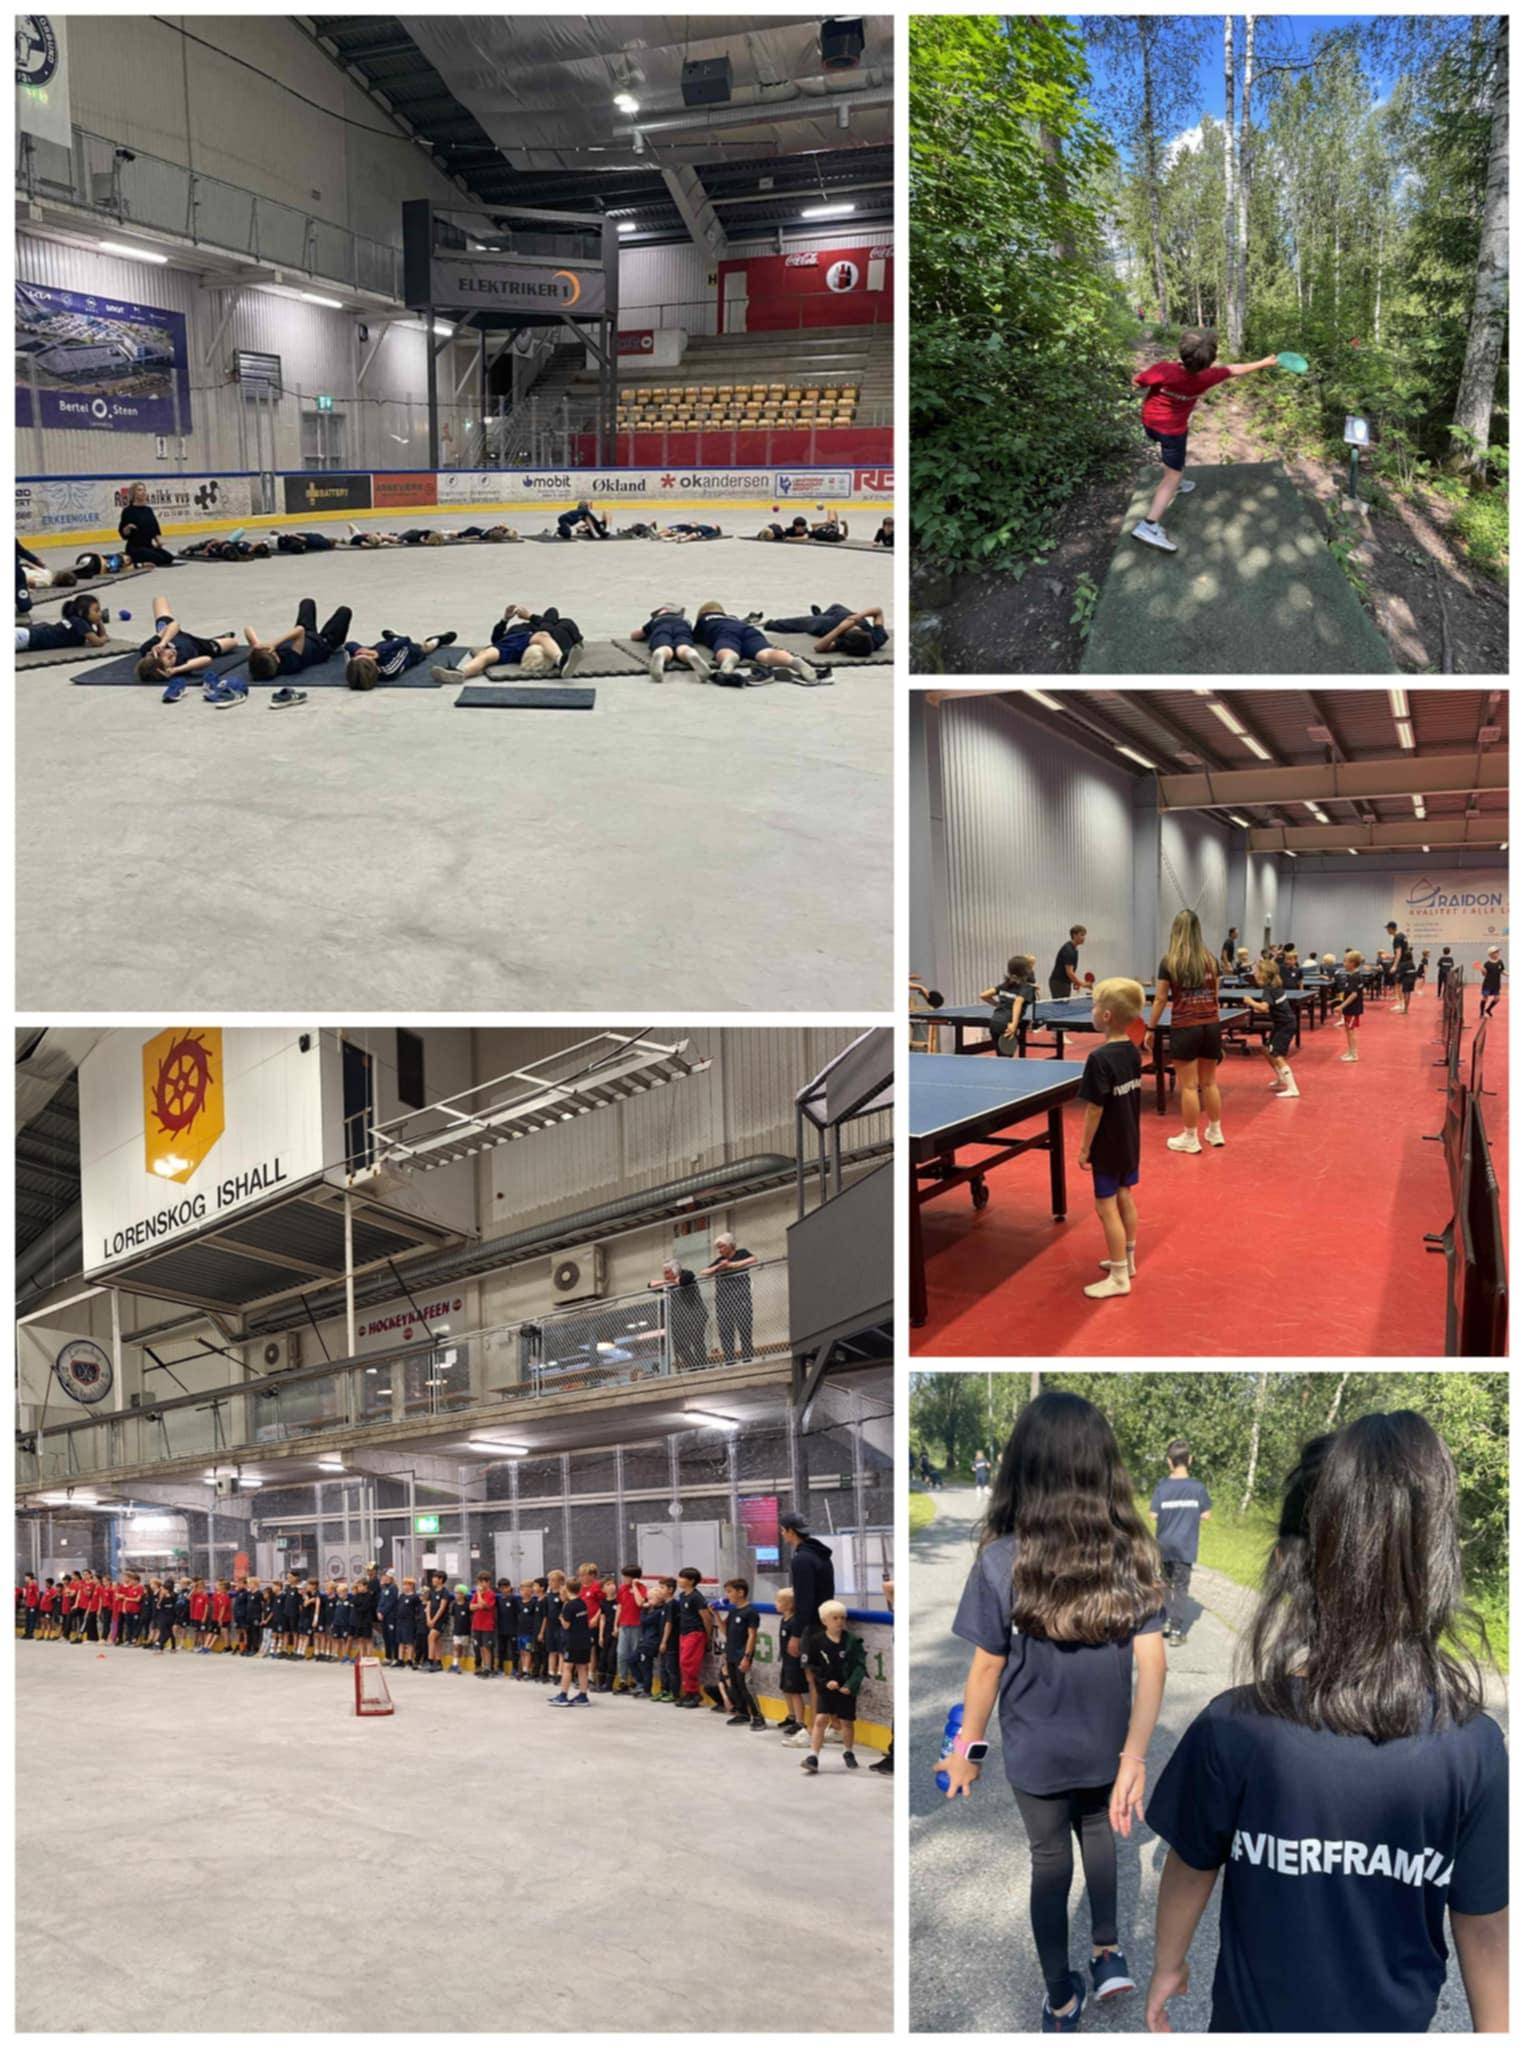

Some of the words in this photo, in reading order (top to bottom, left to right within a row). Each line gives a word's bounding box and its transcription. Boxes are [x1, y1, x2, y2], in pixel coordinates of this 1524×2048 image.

[458, 278, 558, 297] ELEKTRIKER
[59, 400, 88, 413] Bertel
[113, 404, 138, 416] Steen
[534, 475, 571, 488] mobit
[592, 479, 646, 492] Økland
[680, 474, 769, 488] okandersen
[1438, 893, 1502, 907] RAIDON
[103, 1194, 206, 1259] LØRENSKOG
[217, 1157, 287, 1208] ISHALL
